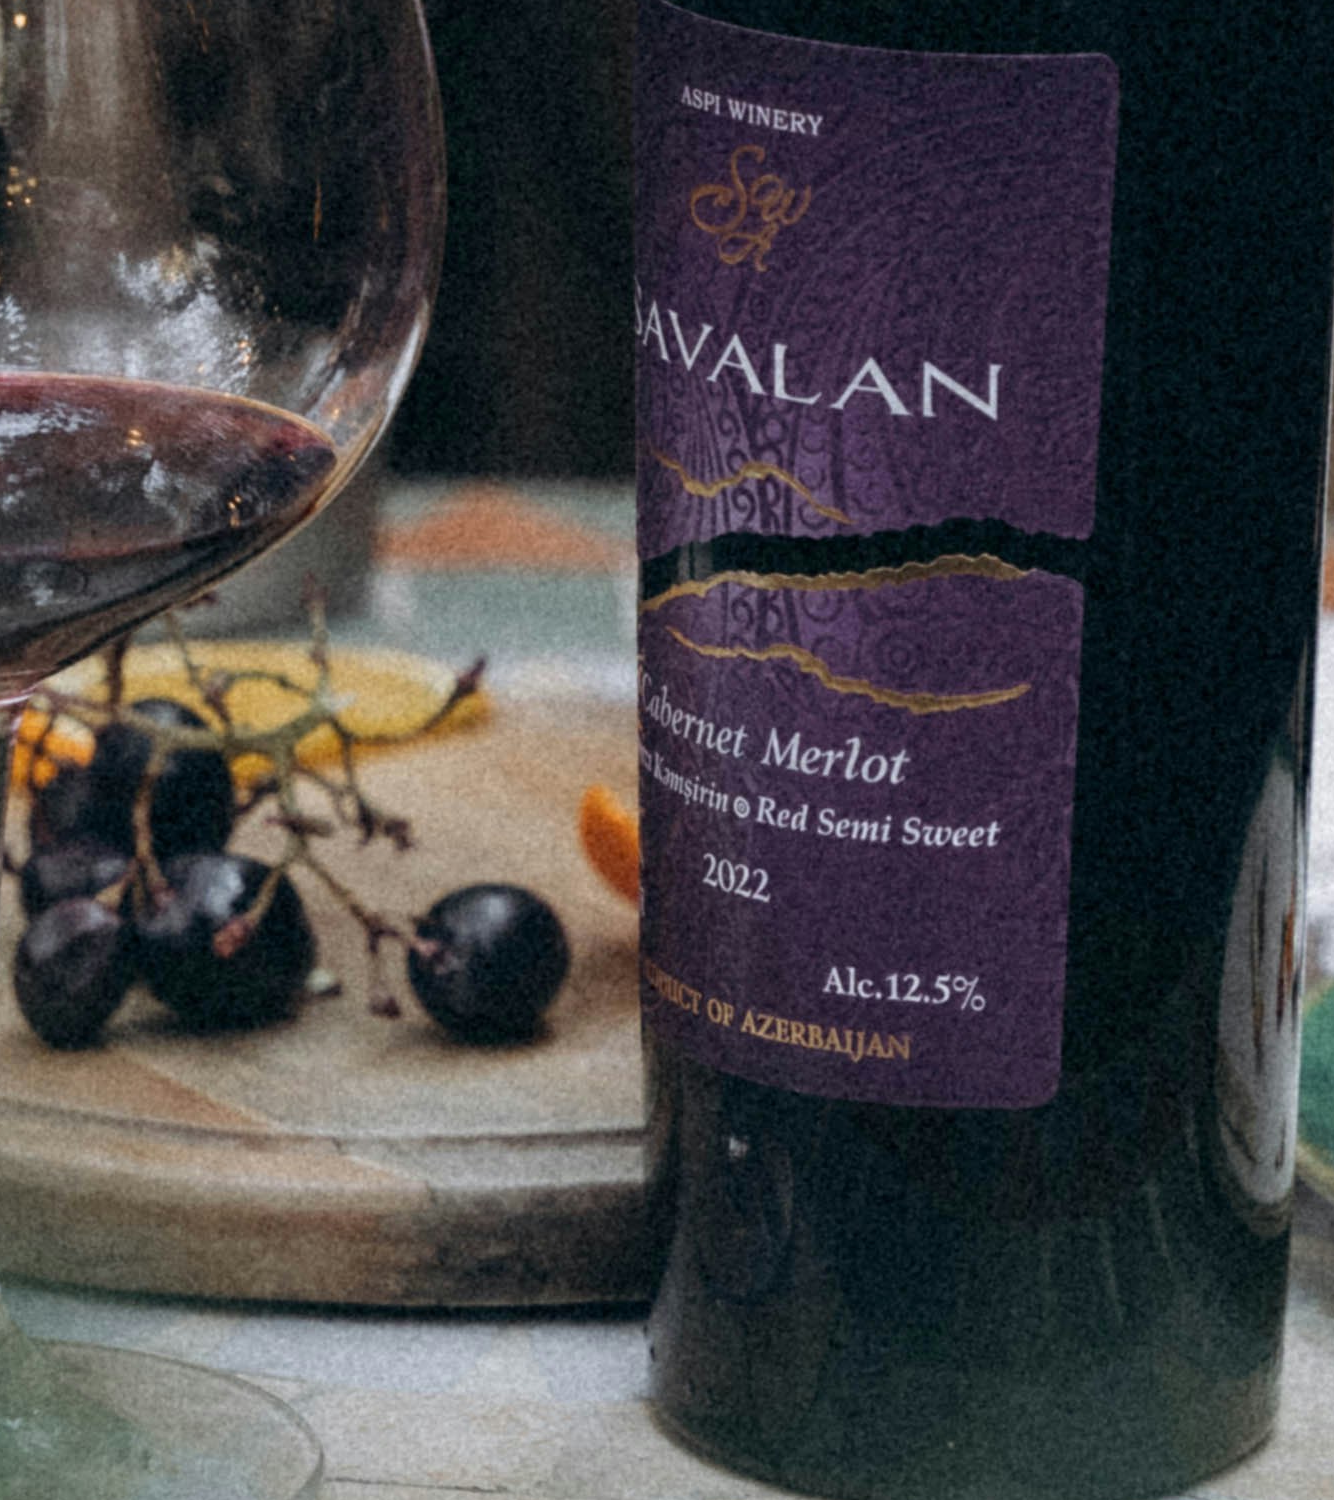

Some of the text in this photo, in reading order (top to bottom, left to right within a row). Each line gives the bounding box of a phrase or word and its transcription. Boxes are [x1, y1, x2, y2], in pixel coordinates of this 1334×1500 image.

[681, 85, 823, 137] ASPI WINERY
[642, 672, 748, 758] Cabernet
[761, 727, 911, 785] Merlot
[756, 795, 808, 833] Red
[817, 807, 892, 844] Semi
[901, 816, 1001, 847] Sweet
[702, 853, 771, 902] 2022
[823, 966, 986, 1012] Alc.12.5%
[707, 997, 734, 1028] OF
[741, 1009, 912, 1062] AZERBAIJAN
